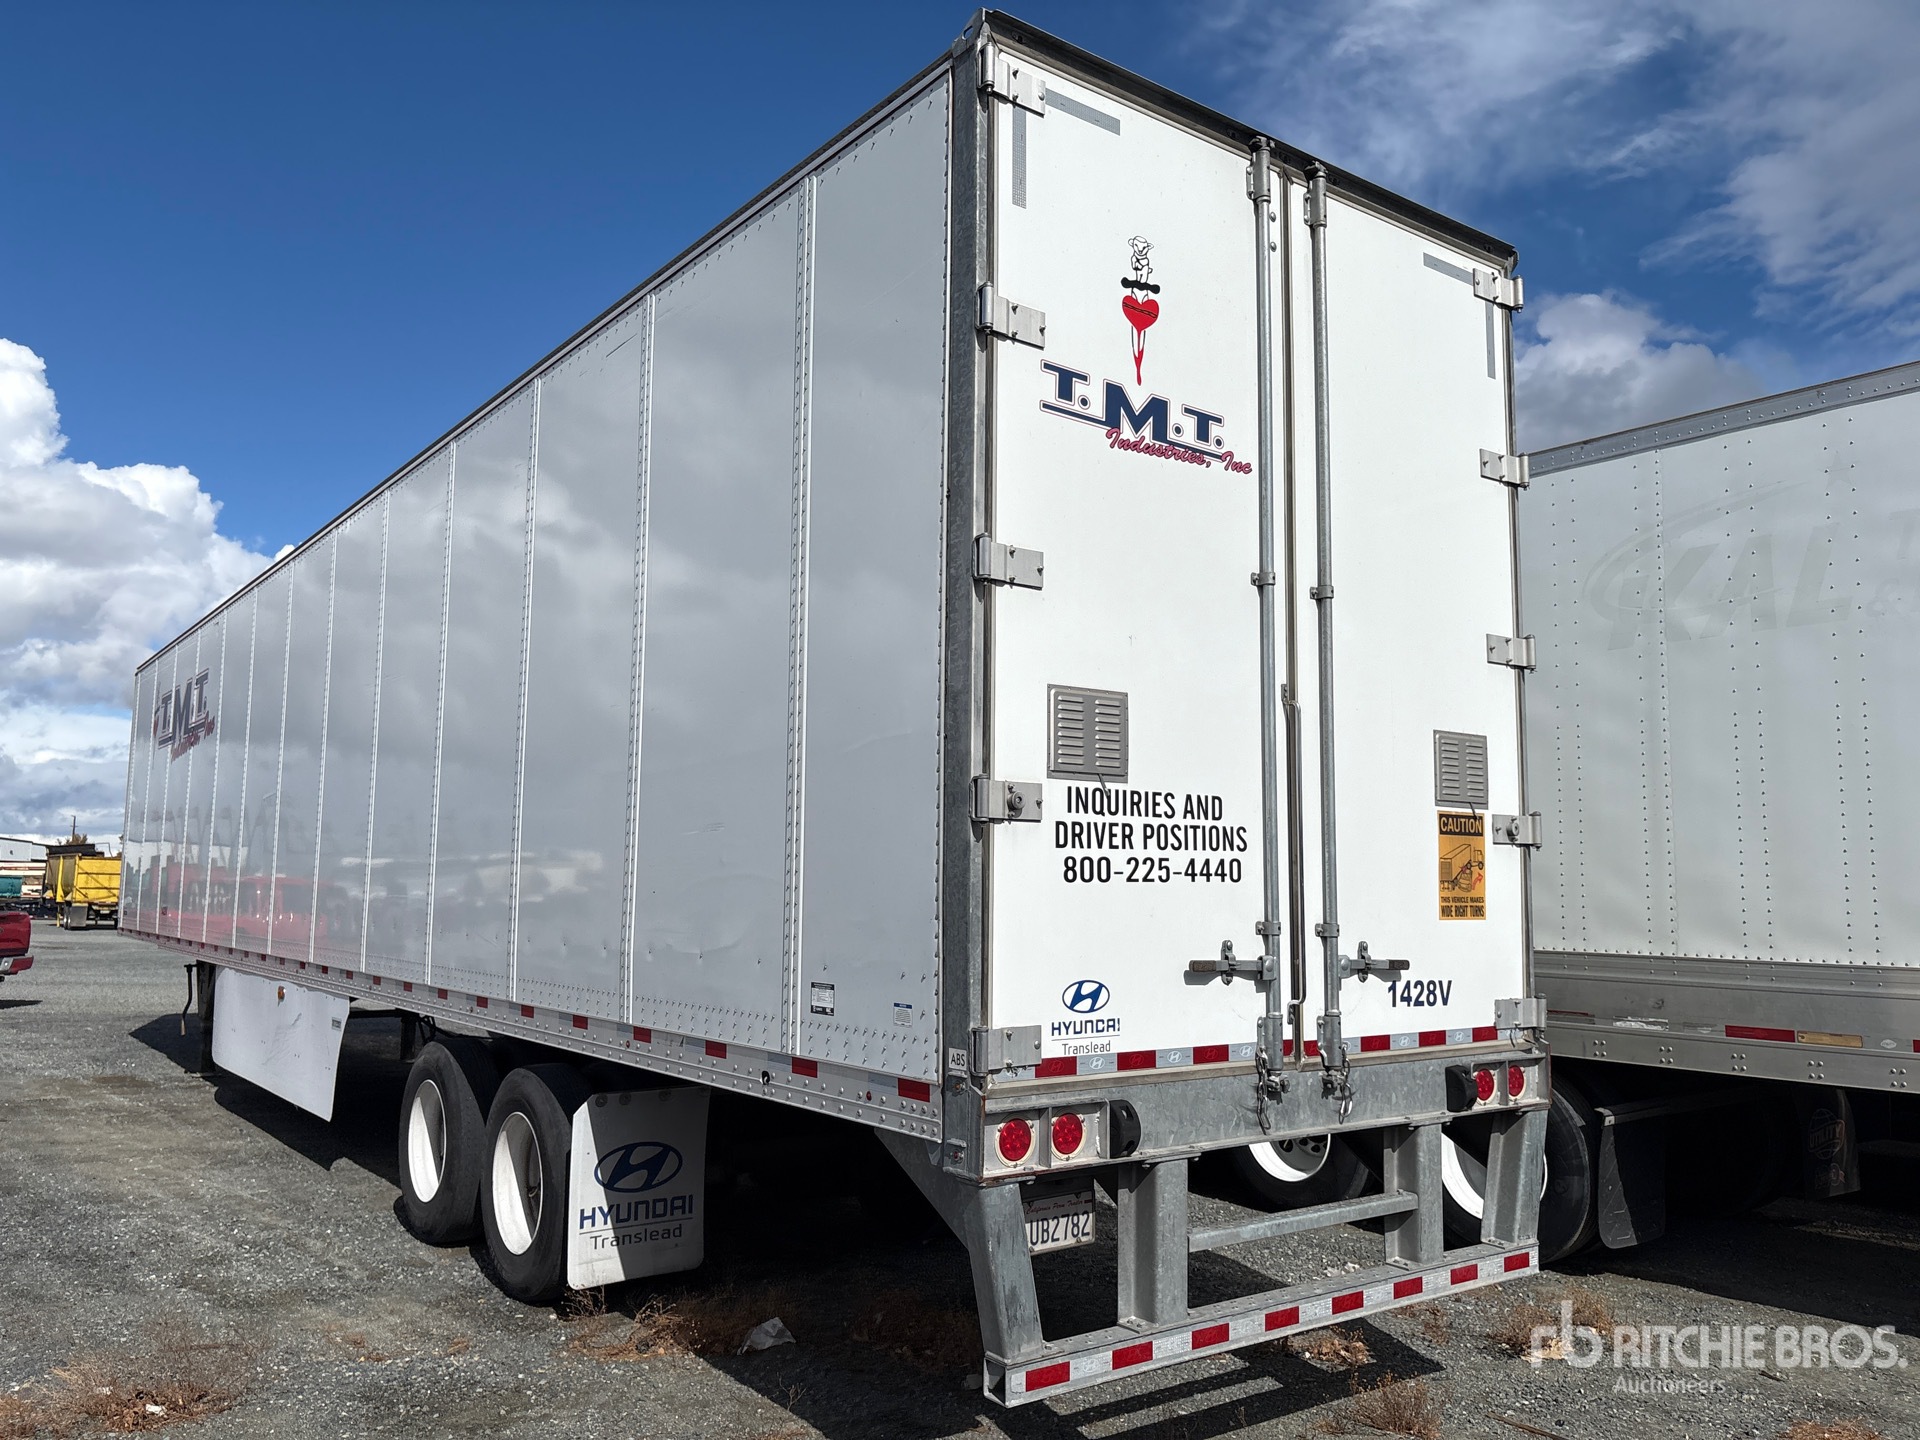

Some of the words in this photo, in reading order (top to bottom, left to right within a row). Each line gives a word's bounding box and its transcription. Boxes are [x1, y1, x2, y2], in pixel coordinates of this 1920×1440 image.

[1041, 359, 1225, 449] T.M.T.
[1106, 428, 1211, 468] Industries,
[1221, 451, 1253, 475] Inc
[1067, 786, 1176, 819] INQUIRIES
[1182, 794, 1223, 821] AND
[1055, 821, 1134, 850] DRIVER
[1143, 823, 1248, 852] POSITIONS
[1440, 816, 1483, 834] CAUTION
[1063, 856, 1242, 883] 800-225-4440
[1388, 980, 1452, 1008] 1428V
[1051, 1018, 1120, 1036] HYUNDAI
[951, 1053, 966, 1067] ABS
[1062, 1040, 1111, 1055] Translead
[579, 1194, 694, 1229] HYUNDAI
[590, 1224, 682, 1250] Translead
